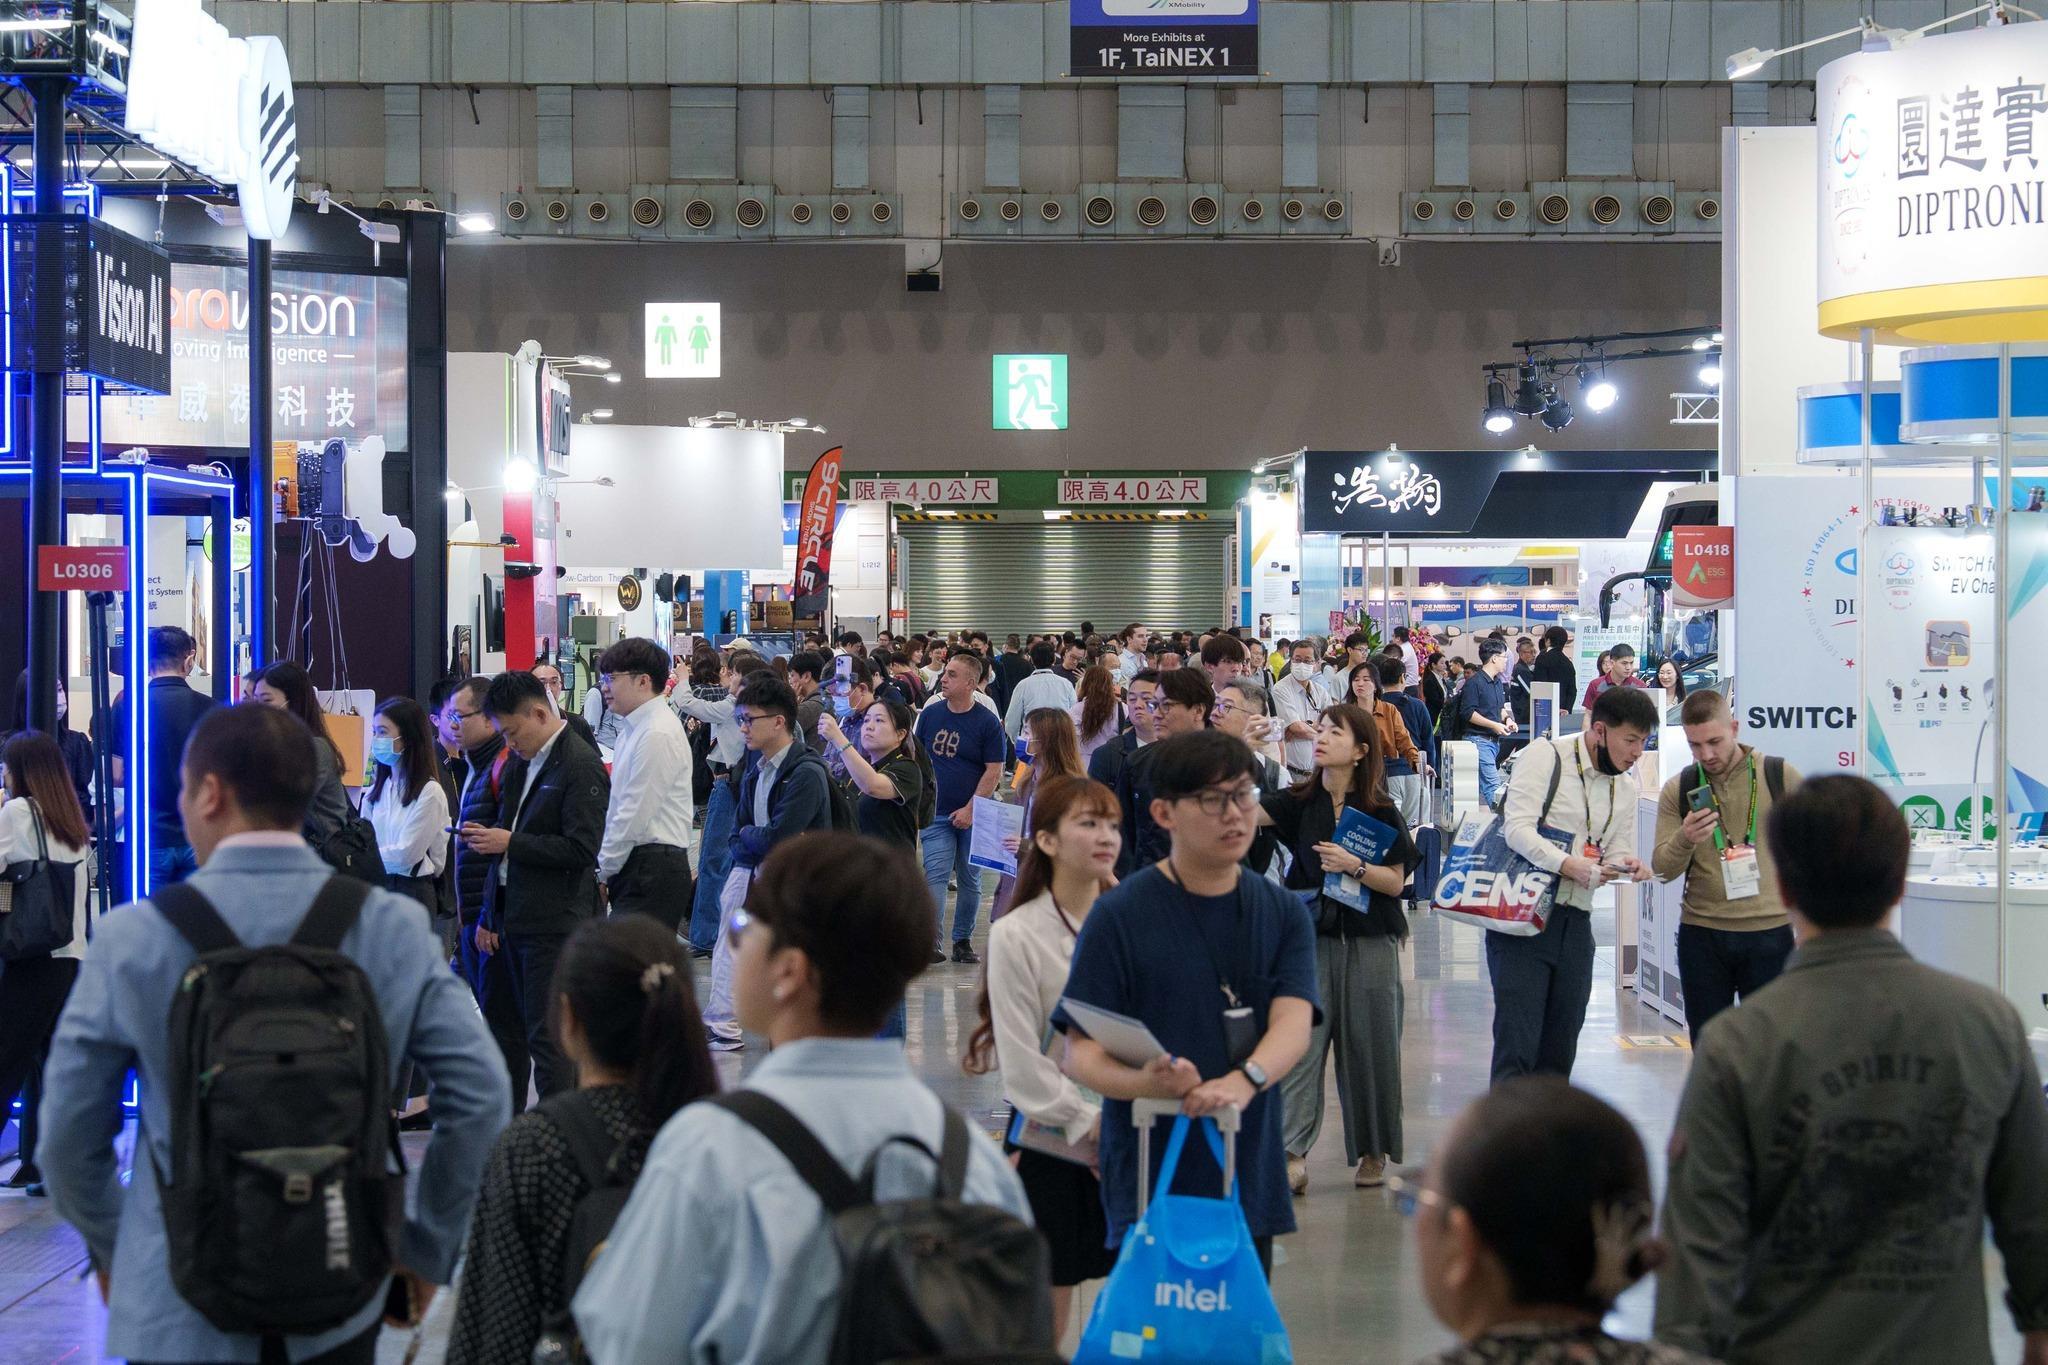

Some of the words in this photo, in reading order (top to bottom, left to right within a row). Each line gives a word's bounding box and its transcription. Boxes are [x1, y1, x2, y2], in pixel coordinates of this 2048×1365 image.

[1123, 33, 1149, 42] More
[1152, 33, 1192, 42] Exhibits
[1195, 33, 1205, 42] at
[1098, 48, 1126, 70] 1F,
[1132, 47, 1215, 67] TaiNEX
[1220, 48, 1229, 67] 1
[96, 251, 145, 348] Vision
[147, 274, 163, 354] AI
[173, 338, 220, 361] oving
[1063, 480, 1200, 501] 限高4.0公尺
[1685, 544, 1730, 556] L0418
[54, 563, 113, 578] L0306
[564, 573, 603, 582] ow-Carbon
[1708, 568, 1725, 577] ESG
[147, 576, 161, 584] ect
[1951, 579, 1968, 594] EV
[155, 588, 183, 598] System
[1835, 599, 1855, 615] DI
[1341, 836, 1354, 848] The
[1354, 841, 1376, 858] World
[1346, 830, 1378, 848] COOLING
[1435, 870, 1551, 908] CENS
[1154, 1278, 1227, 1312] intel
